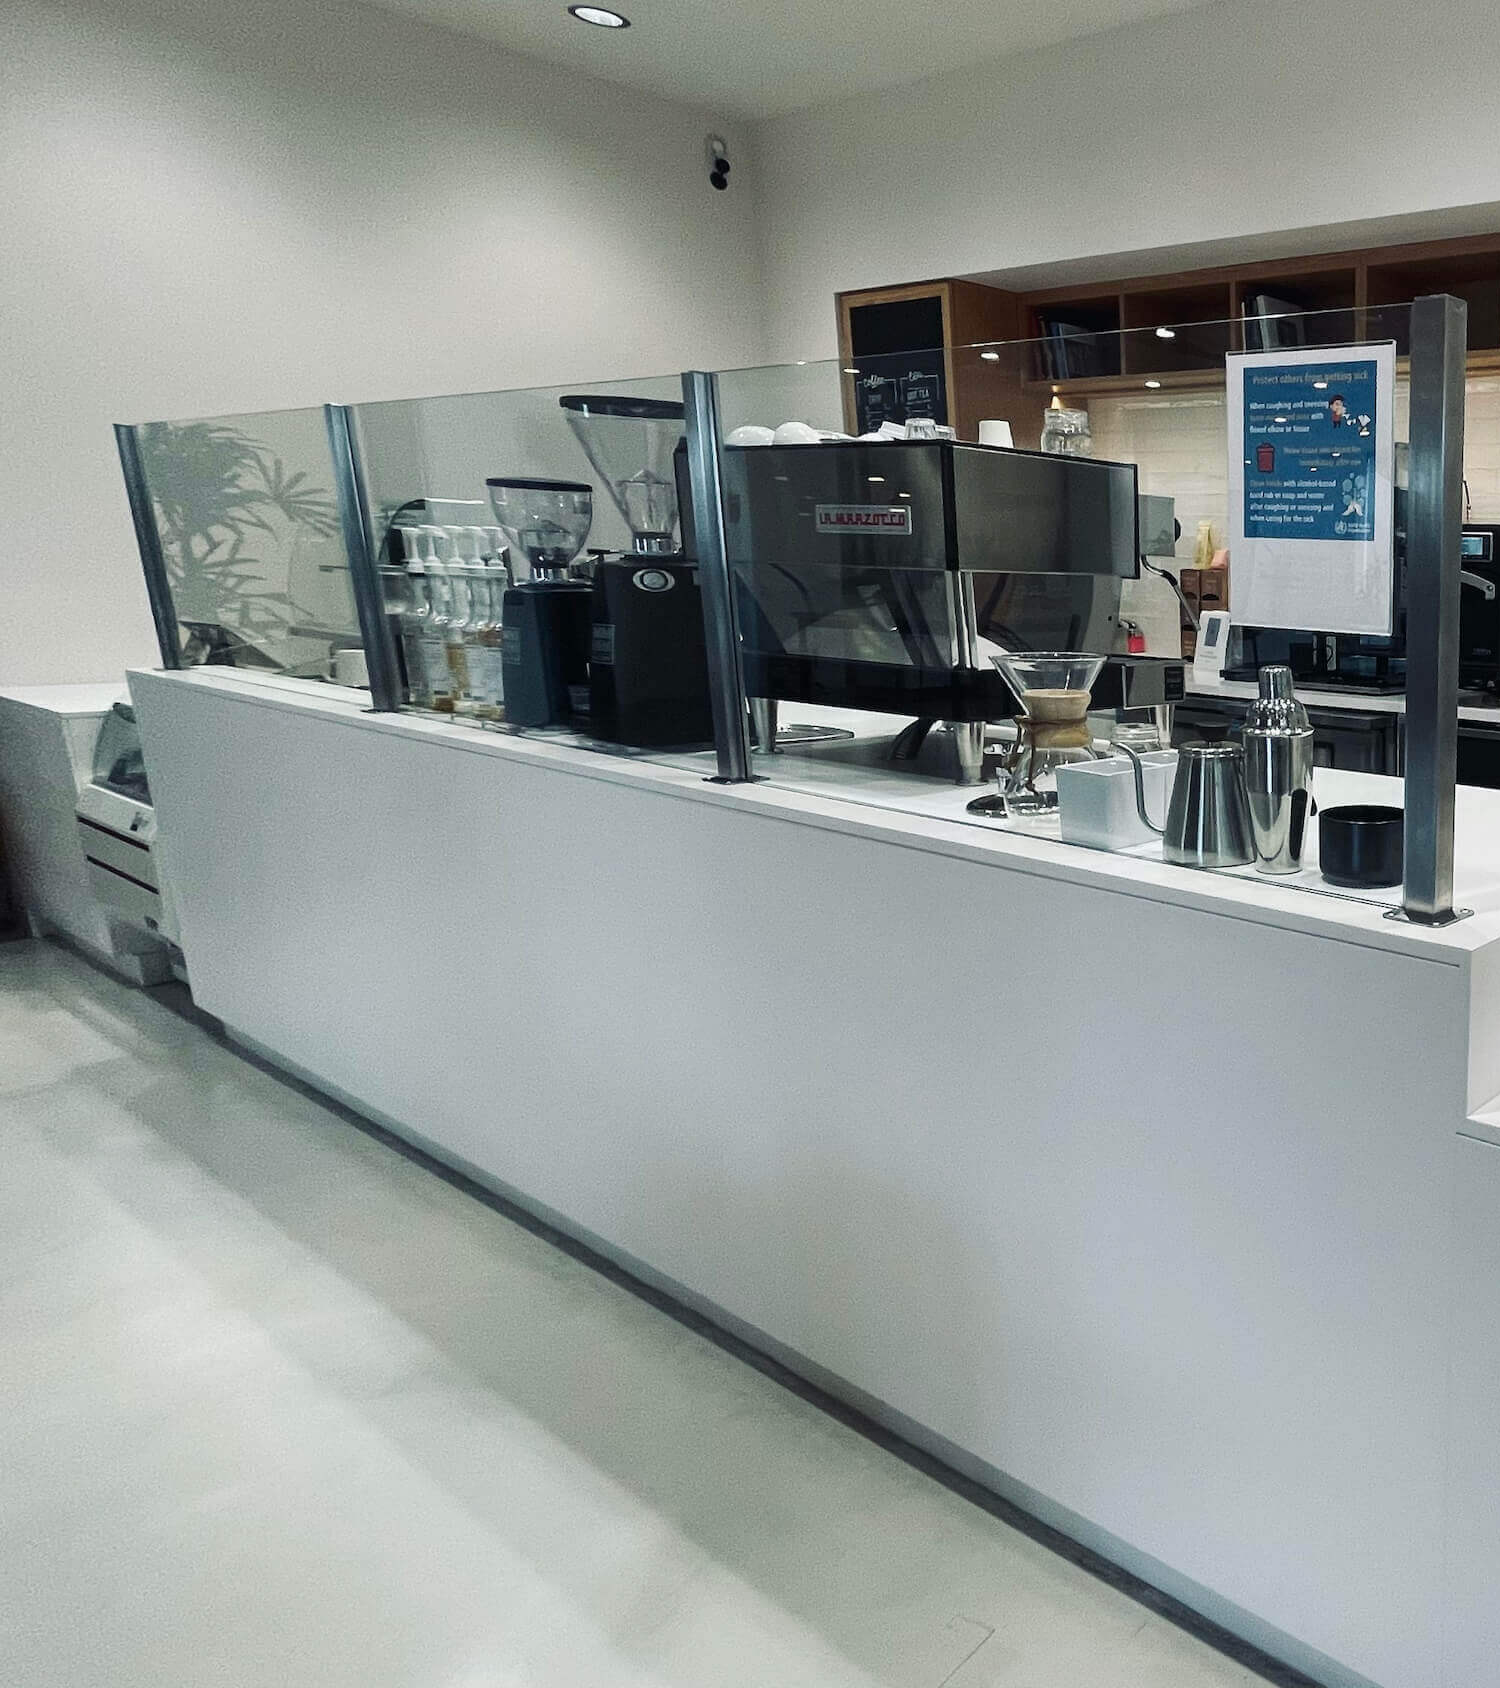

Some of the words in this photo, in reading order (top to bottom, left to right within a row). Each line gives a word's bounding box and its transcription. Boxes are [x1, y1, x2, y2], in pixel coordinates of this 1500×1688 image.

[1253, 376, 1278, 384] Protect
[1279, 375, 1303, 383] others
[1249, 402, 1265, 410] When
[1266, 402, 1291, 410] coughing
[1292, 400, 1303, 409] and
[1296, 491, 1307, 499] and
[1264, 504, 1289, 512] coughing
[820, 514, 834, 525] LA
